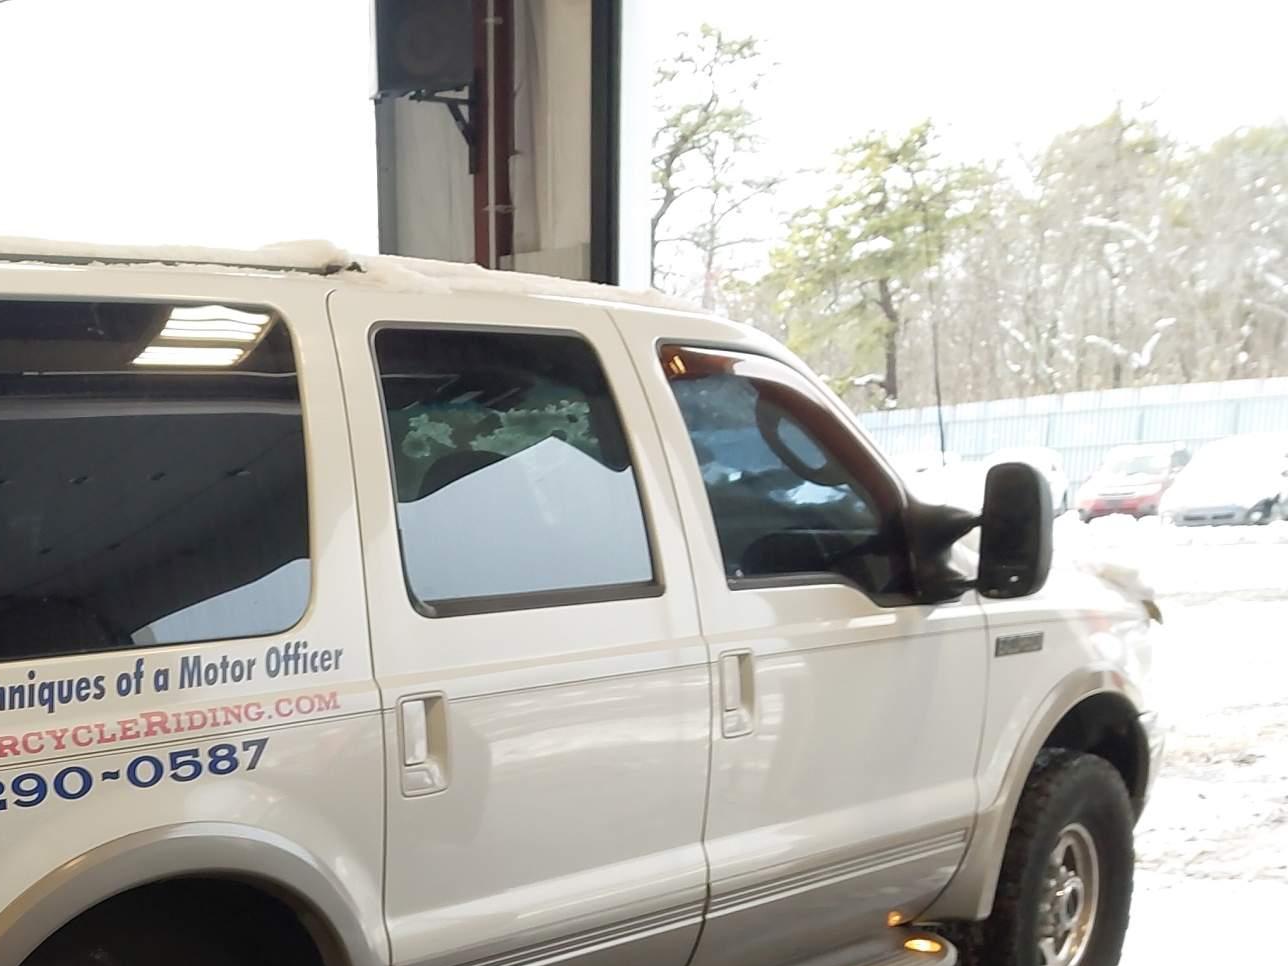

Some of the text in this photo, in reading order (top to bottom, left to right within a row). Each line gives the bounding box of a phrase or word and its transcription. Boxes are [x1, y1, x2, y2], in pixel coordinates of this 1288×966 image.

[116, 658, 145, 697] of
[153, 670, 170, 691] a
[179, 654, 256, 690] Motor
[265, 640, 345, 679] Officer
